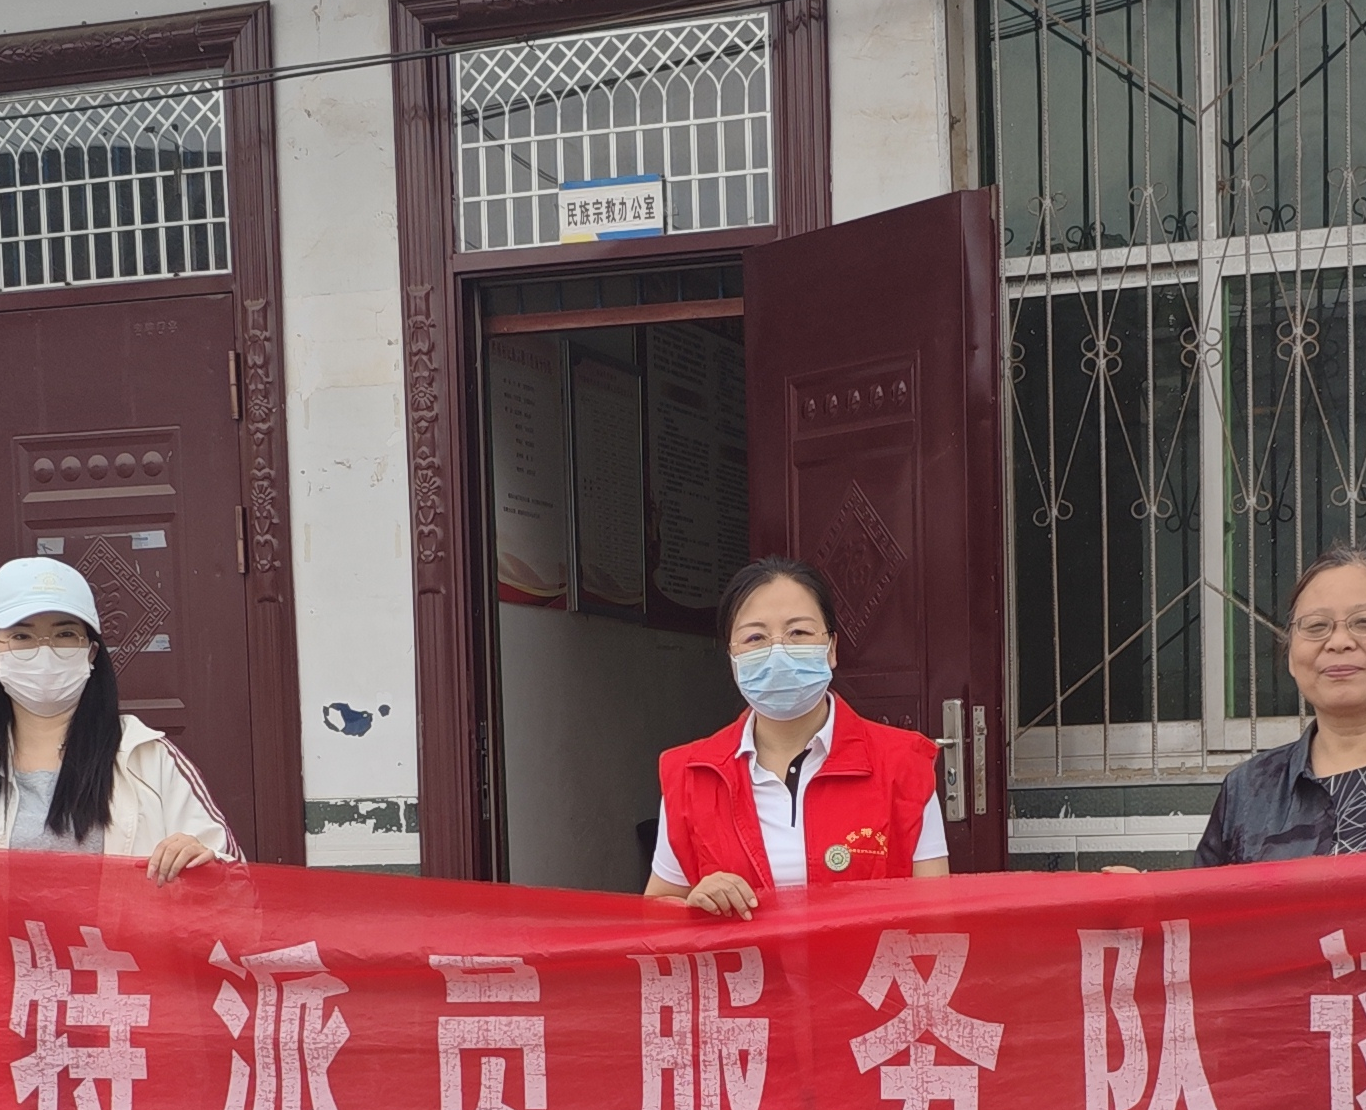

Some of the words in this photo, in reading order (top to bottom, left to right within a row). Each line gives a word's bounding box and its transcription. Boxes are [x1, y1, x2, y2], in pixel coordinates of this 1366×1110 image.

[566, 194, 657, 227] 民族宗教办公室
